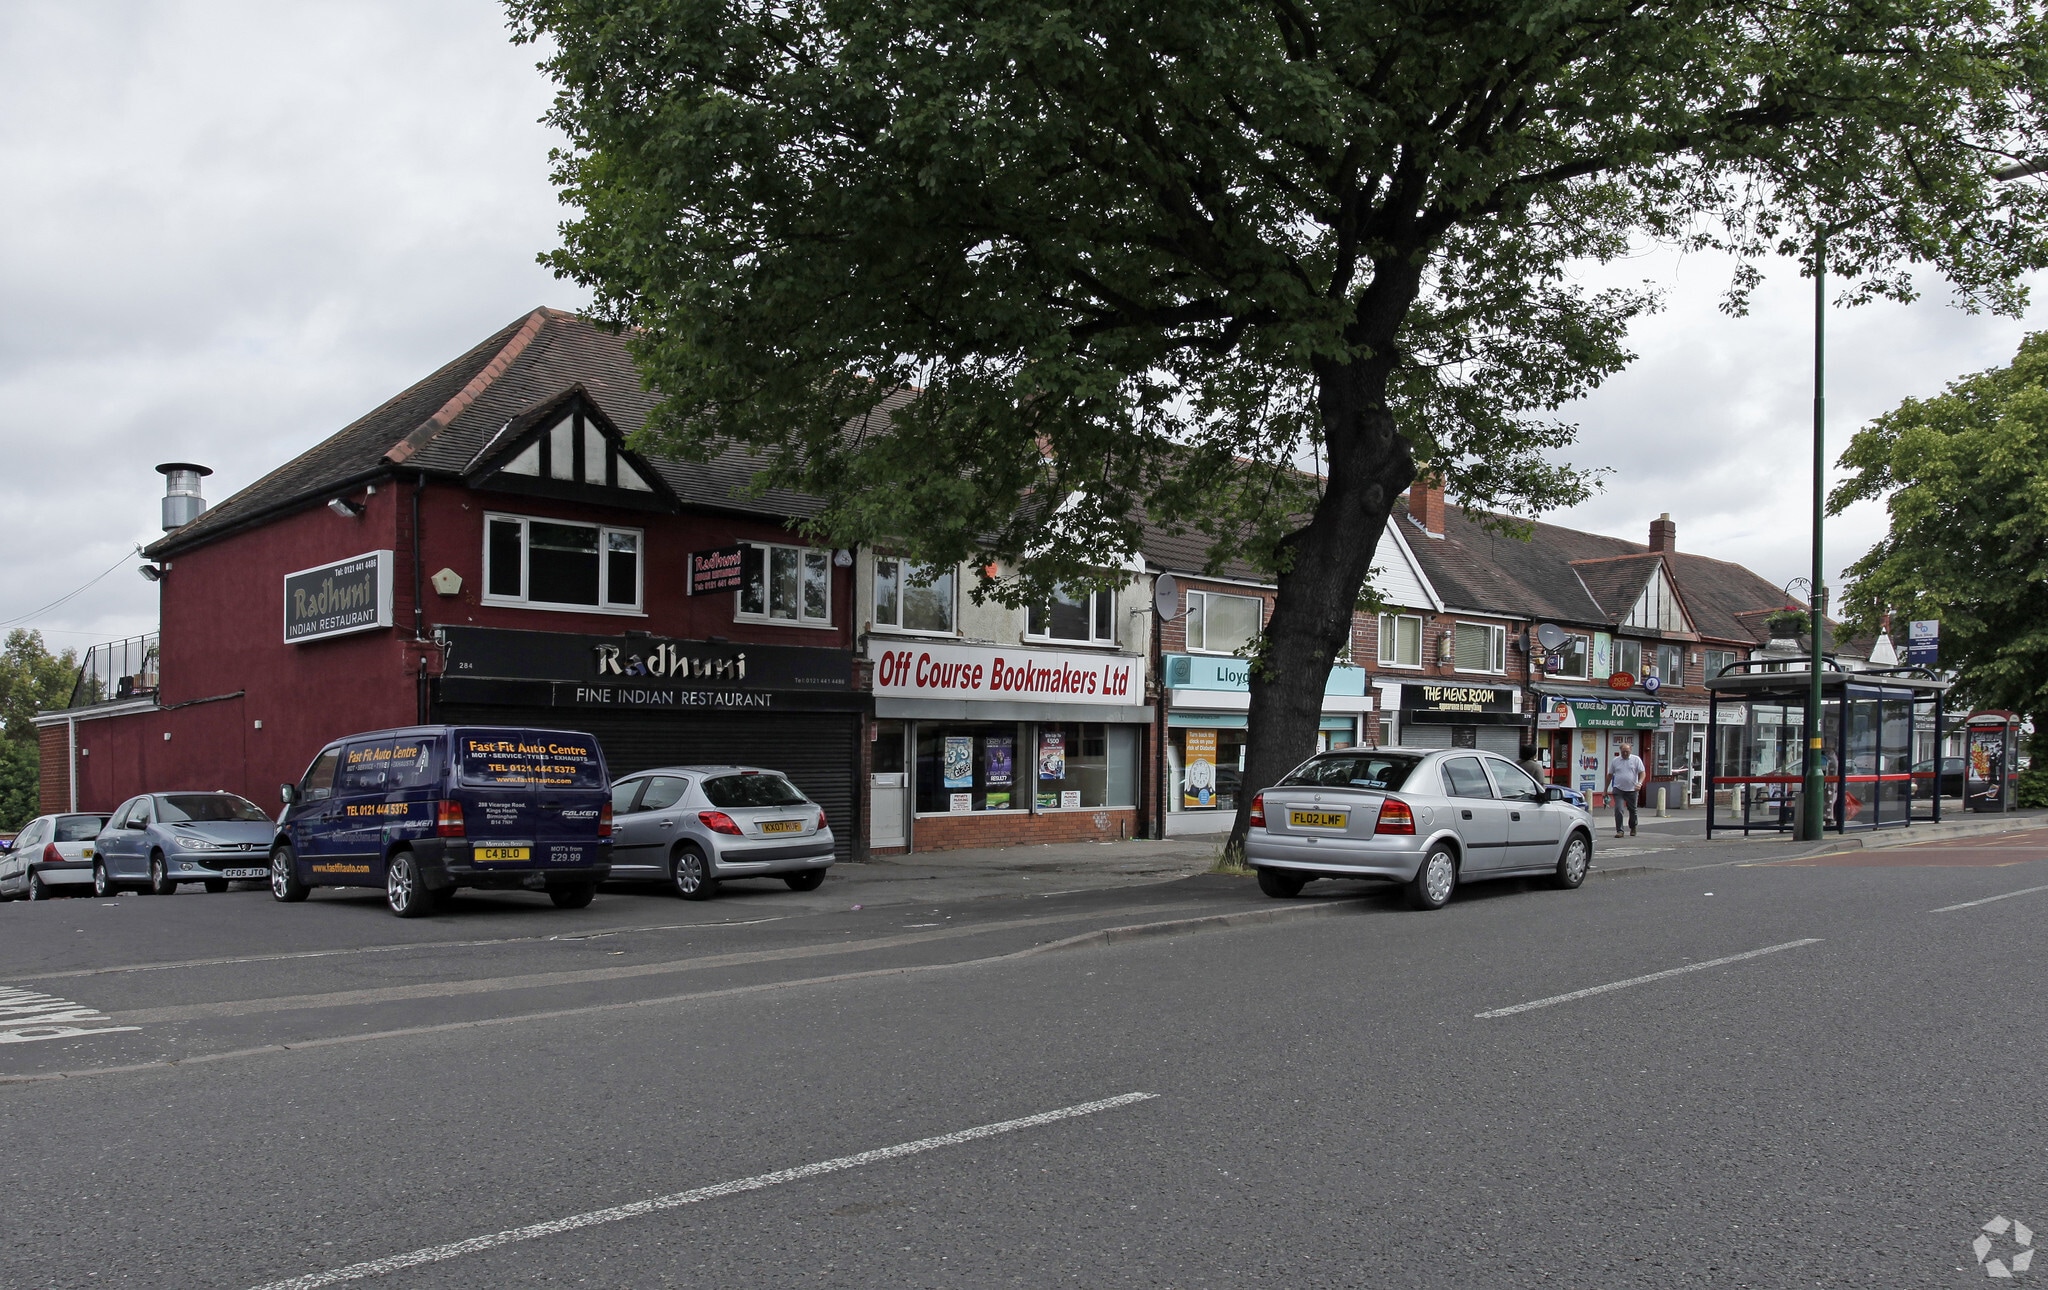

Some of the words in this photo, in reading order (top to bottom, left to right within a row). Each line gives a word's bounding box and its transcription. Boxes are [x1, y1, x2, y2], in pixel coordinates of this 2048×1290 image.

[335, 567, 344, 576] Tel:
[344, 564, 355, 575] 0121
[356, 562, 365, 572] 441
[294, 573, 370, 620] Radhuni
[289, 621, 317, 636] INDIAN
[320, 608, 374, 630] RESTAURANT
[593, 643, 746, 680] Radhuni
[879, 650, 912, 687] Off
[916, 652, 983, 689] Course
[990, 657, 1097, 694] Bookmakers
[1102, 664, 1130, 696] Ltd
[576, 687, 611, 703] FINE
[618, 689, 674, 704] INDIAN
[681, 690, 772, 707] RESTAURANT
[1423, 686, 1442, 701] THE
[1443, 687, 1467, 702] MENS
[1469, 688, 1495, 703] ROOM
[1576, 702, 1595, 710] VICARAGE
[1611, 704, 1630, 717] POST
[1632, 705, 1655, 718] OFFICE
[1669, 710, 1699, 721] Acclaim
[348, 750, 362, 763] Fast
[362, 748, 374, 762] Fit
[373, 748, 392, 760] Auto
[393, 746, 418, 758] Centre
[469, 741, 497, 752] Fast
[498, 742, 514, 752] Fit
[518, 743, 546, 754] Auto
[549, 744, 587, 756] Centre
[488, 764, 508, 772] TEL
[510, 764, 532, 772] 0121
[554, 766, 576, 774] 5375
[347, 806, 358, 816] TEL
[360, 804, 375, 816] 0121
[376, 804, 390, 814] 444
[390, 803, 408, 814] 5375
[1294, 812, 1319, 824] FL02
[1321, 814, 1342, 824] LMF
[765, 823, 784, 832] KX07
[485, 849, 498, 858] C4
[500, 848, 520, 858] BLO
[550, 853, 581, 862] £29.99
[225, 868, 247, 877] CF05
[312, 862, 370, 872] www.fastfitauto.com
